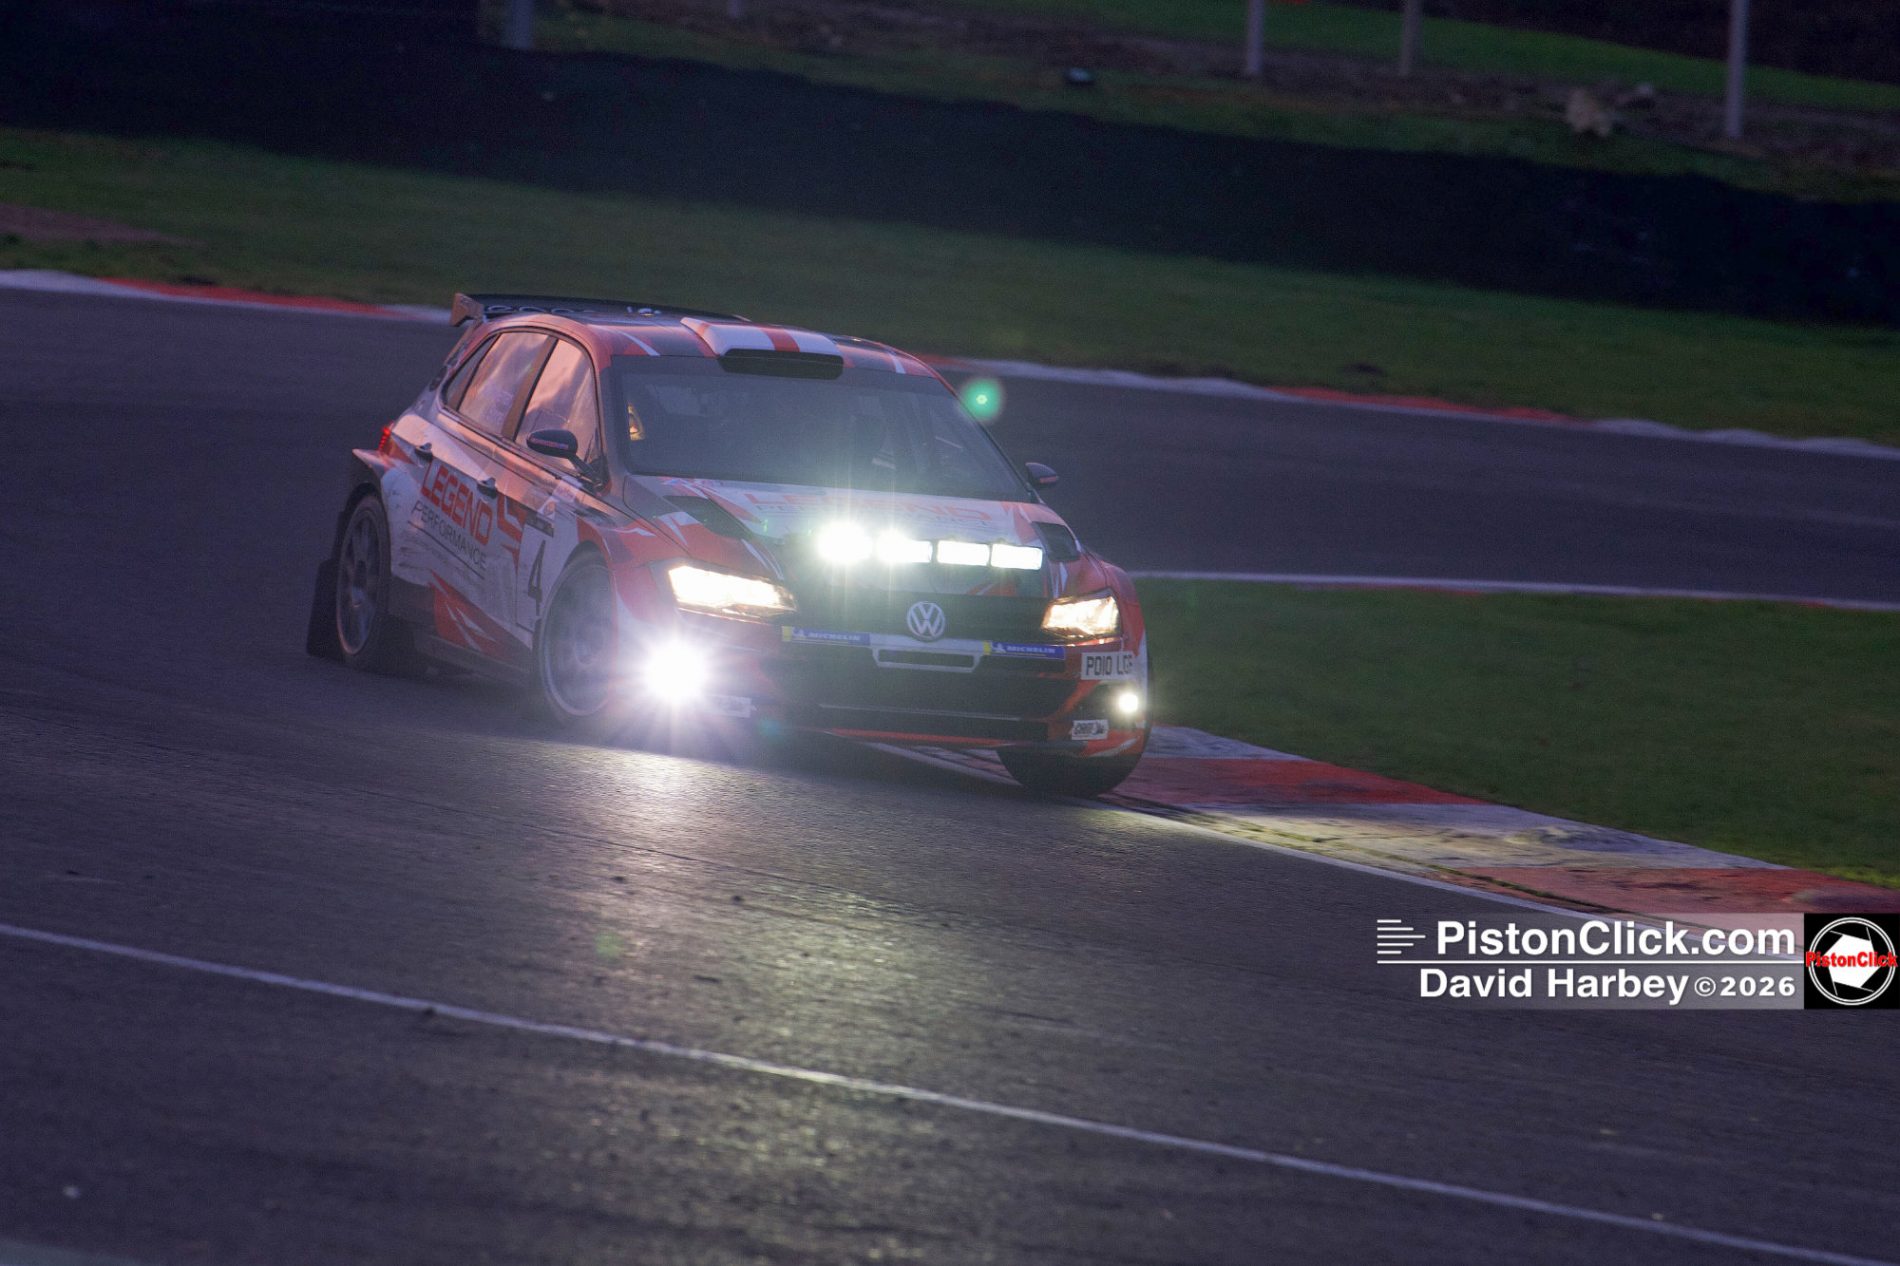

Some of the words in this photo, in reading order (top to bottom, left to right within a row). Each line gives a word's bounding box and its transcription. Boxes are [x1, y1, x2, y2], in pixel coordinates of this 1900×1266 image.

[420, 462, 493, 546] LEGEND
[745, 493, 992, 521] LEND
[411, 500, 487, 571] PERFORMANCE
[527, 539, 546, 616] 4
[808, 632, 861, 642] MICHELIN
[1007, 646, 1056, 655] MICHELIN
